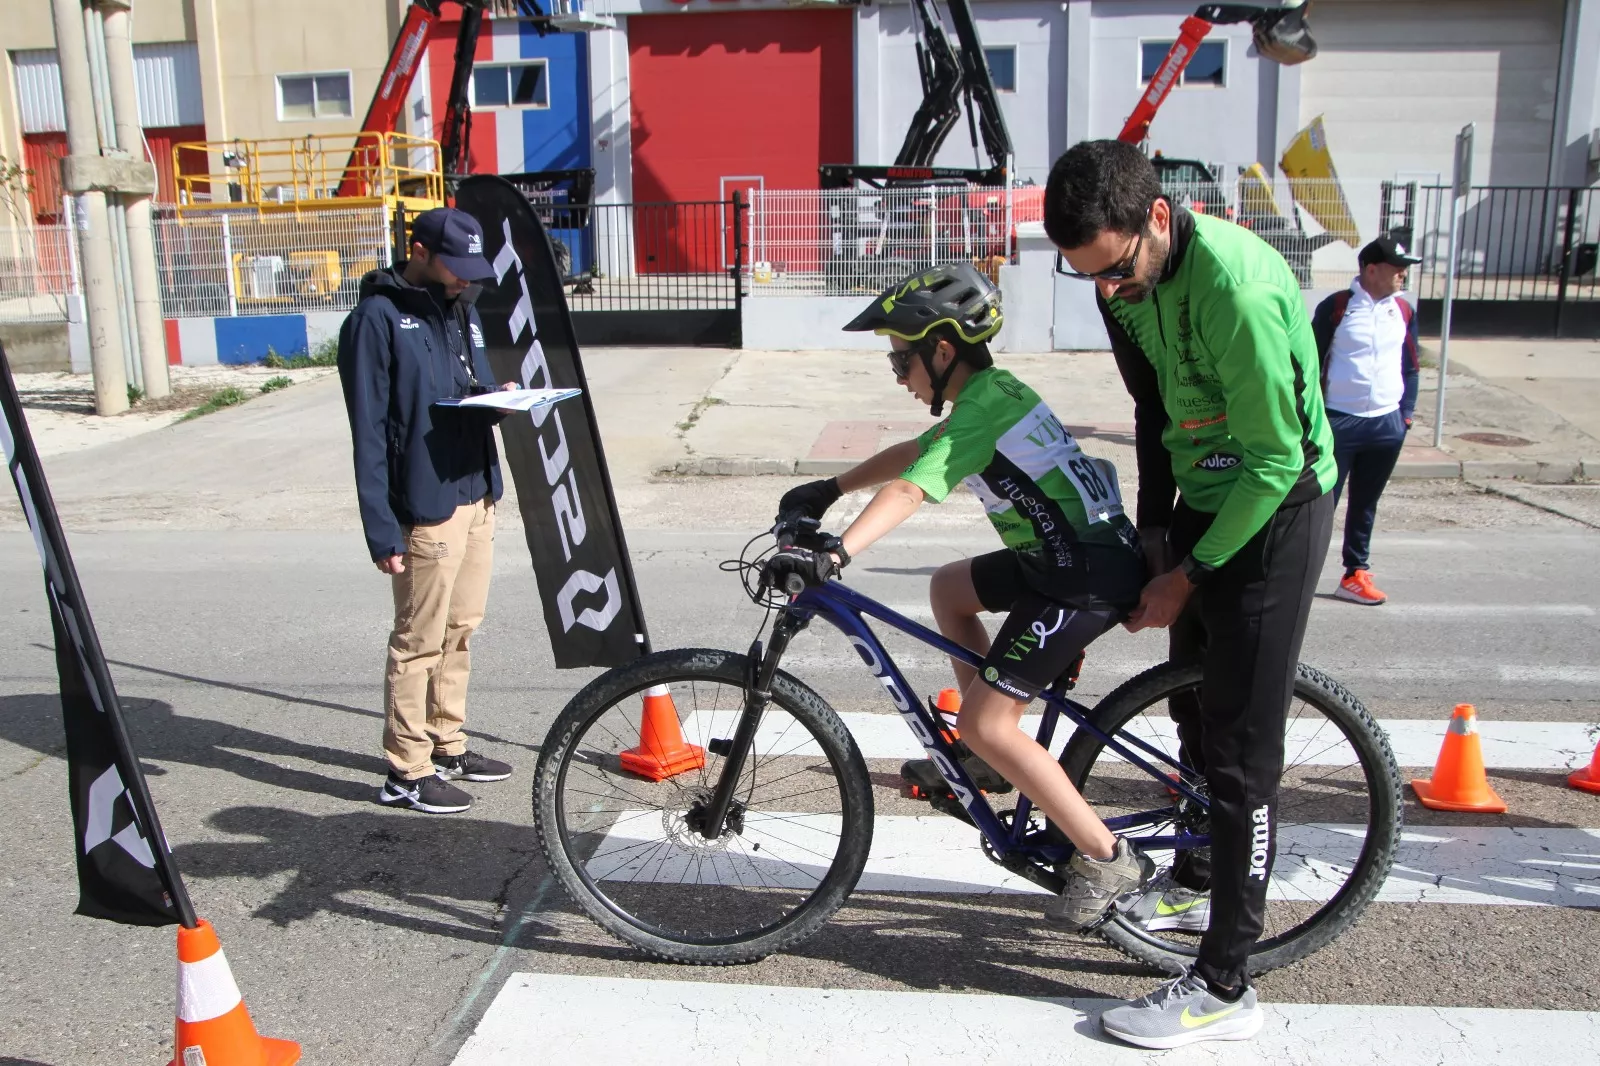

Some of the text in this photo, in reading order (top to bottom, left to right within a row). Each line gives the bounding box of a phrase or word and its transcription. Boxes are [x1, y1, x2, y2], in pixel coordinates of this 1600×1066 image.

[1146, 43, 1188, 107] MANITOU
[886, 167, 933, 179] MANITOU
[1068, 457, 1109, 503] 68
[1198, 453, 1238, 468] vulco
[995, 679, 1031, 698] NUTRITION
[846, 635, 974, 810] ORBEA
[545, 721, 581, 790] KENDA
[1338, 847, 1385, 918] KENDA
